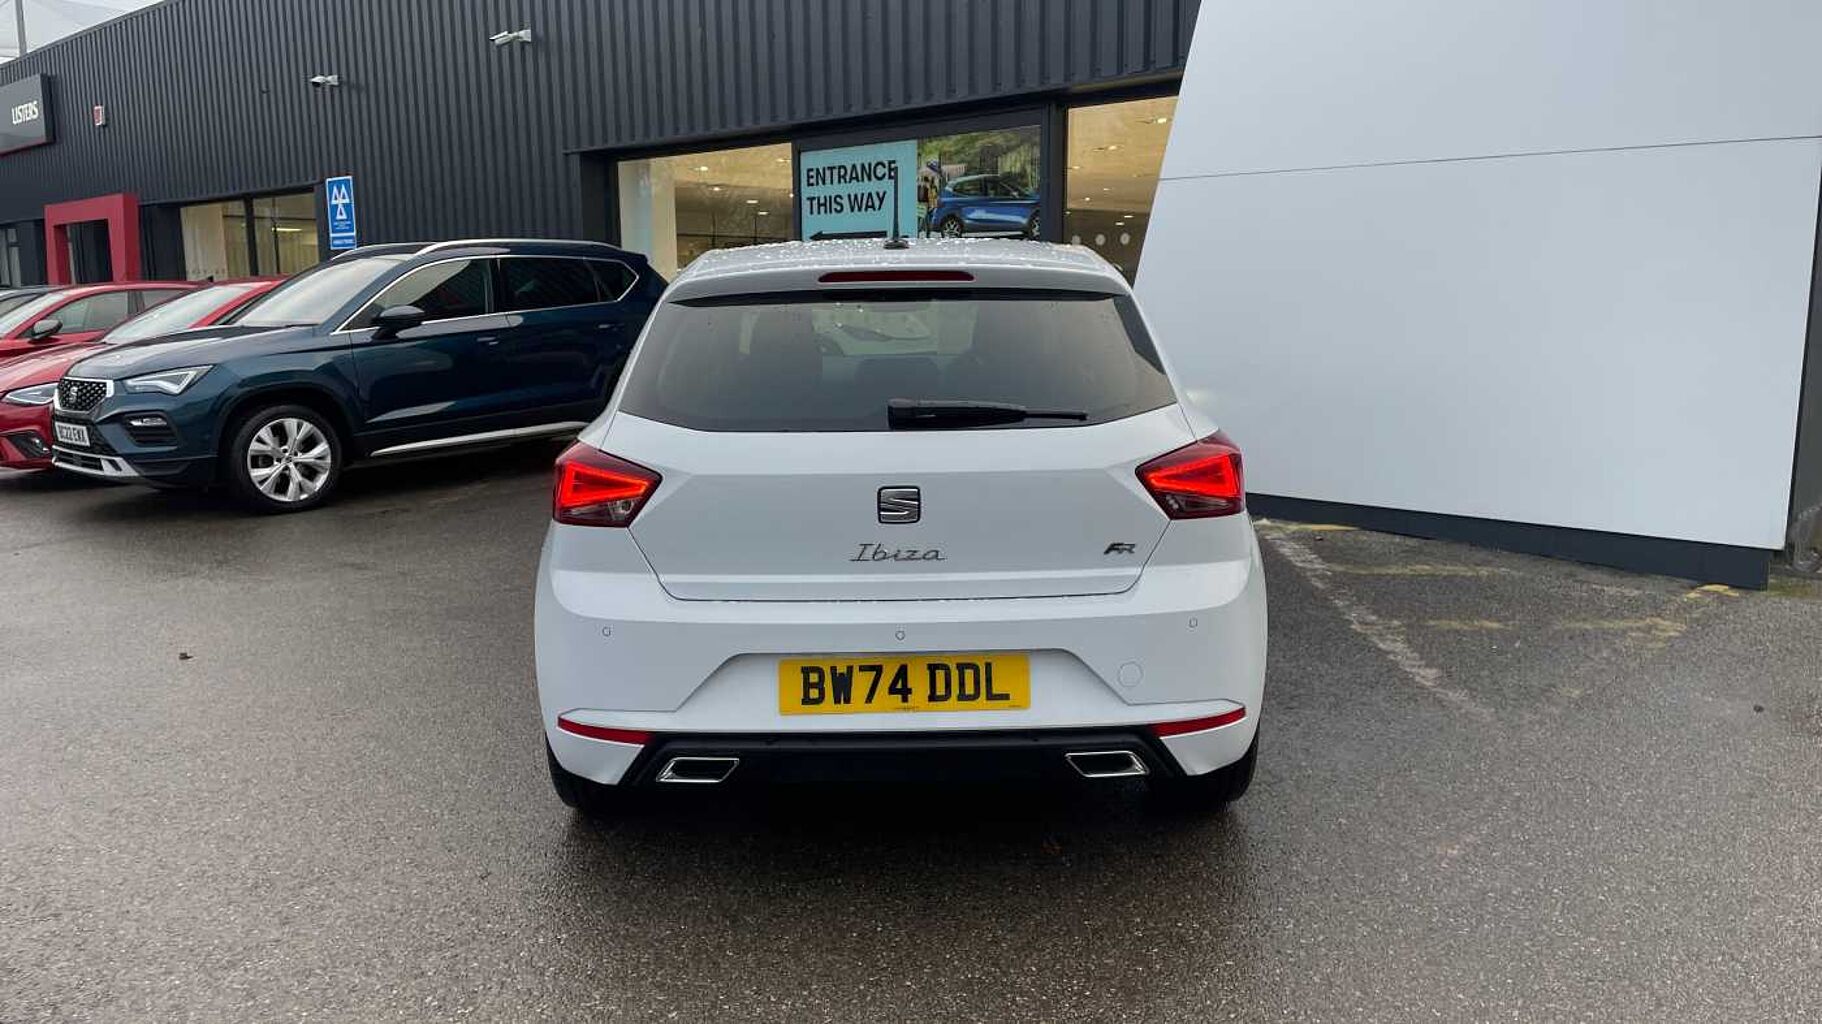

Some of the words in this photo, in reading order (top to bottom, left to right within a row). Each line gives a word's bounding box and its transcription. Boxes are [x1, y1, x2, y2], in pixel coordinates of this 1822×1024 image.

[12, 100, 39, 124] LISTERS
[806, 160, 896, 187] ENTRANCE
[806, 194, 844, 215] THIS
[847, 190, 887, 212] WAY
[849, 542, 946, 561] Ibiza
[1103, 542, 1136, 554] FR
[801, 664, 912, 705] BW74
[926, 662, 1011, 702] DDL
